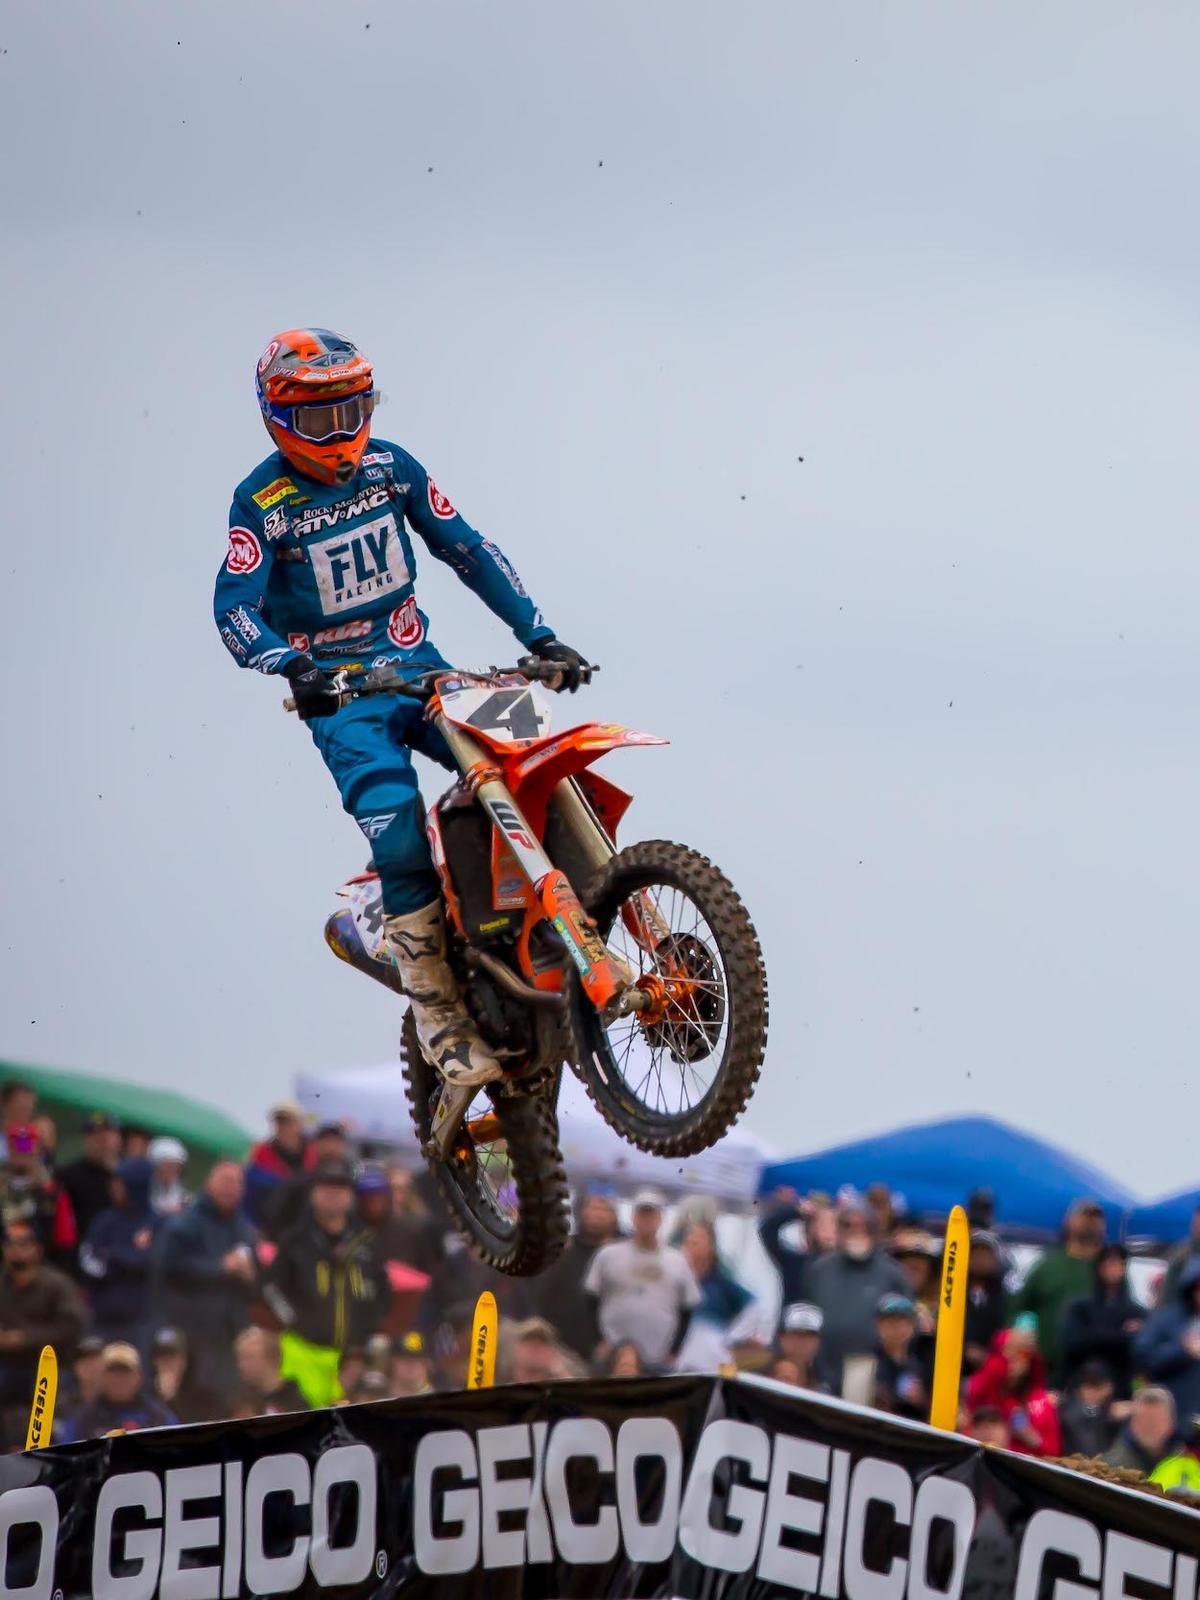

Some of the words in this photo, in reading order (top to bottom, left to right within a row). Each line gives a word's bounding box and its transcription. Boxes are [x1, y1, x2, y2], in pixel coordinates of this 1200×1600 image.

[325, 525, 389, 591] FLY
[335, 573, 393, 603] RACING
[465, 689, 544, 740] 4
[92, 1445, 377, 1600] GEICO
[414, 1417, 682, 1575] GEICO
[679, 1419, 976, 1600] GEICO
